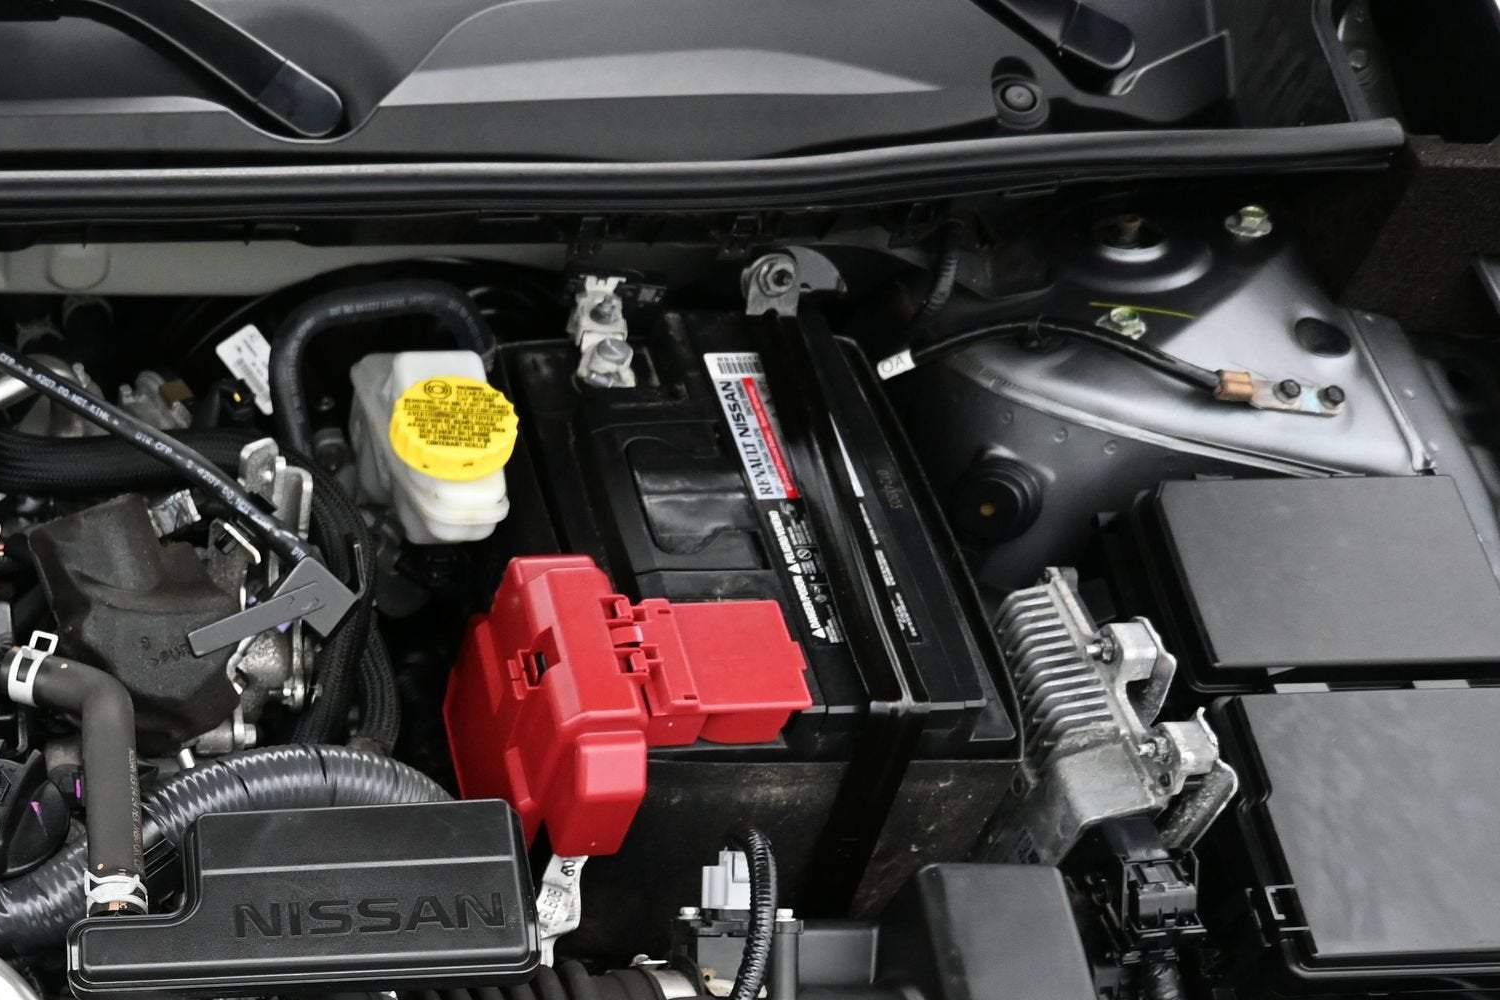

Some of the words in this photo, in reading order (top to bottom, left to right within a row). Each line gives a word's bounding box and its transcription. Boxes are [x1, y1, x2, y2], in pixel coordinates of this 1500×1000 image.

[719, 381, 752, 438] NISSAN
[743, 442, 774, 495] RENAULT
[234, 892, 506, 939] NISSAN
